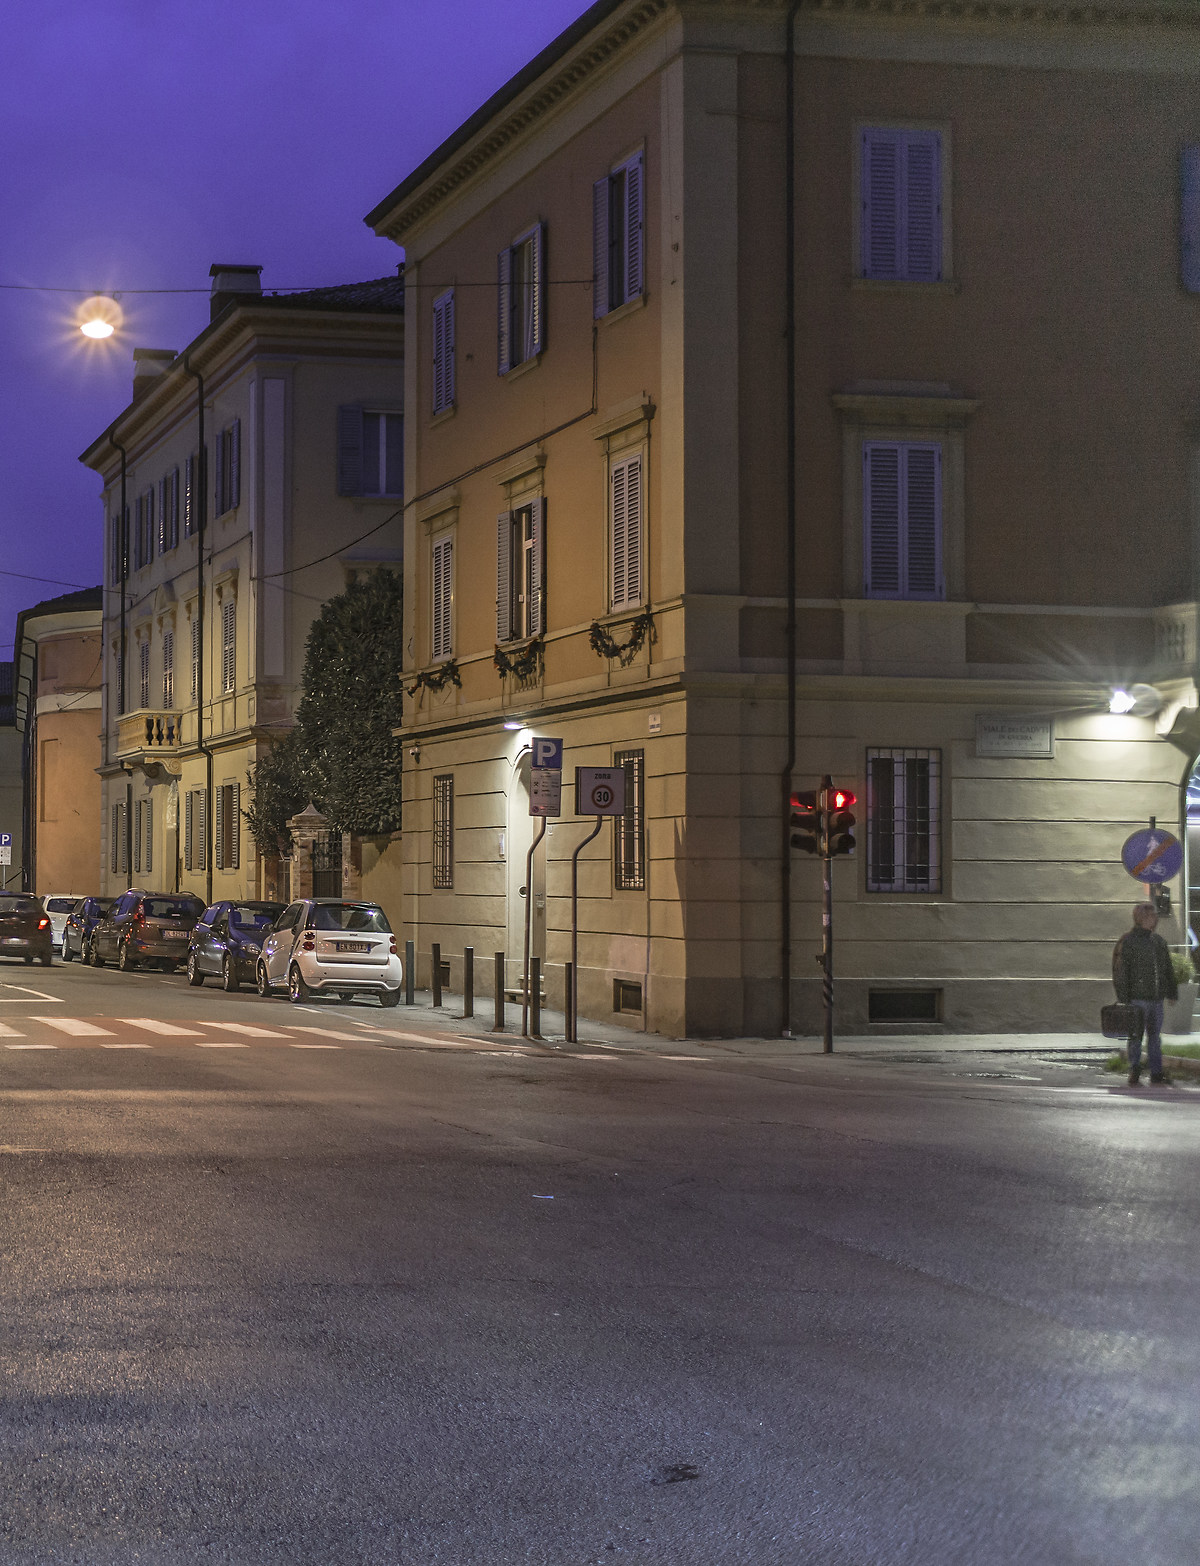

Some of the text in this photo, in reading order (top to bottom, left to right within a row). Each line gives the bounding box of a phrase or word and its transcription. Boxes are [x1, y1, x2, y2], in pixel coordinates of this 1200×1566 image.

[537, 741, 556, 766] P
[596, 791, 609, 802] 30
[1, 834, 10, 845] P
